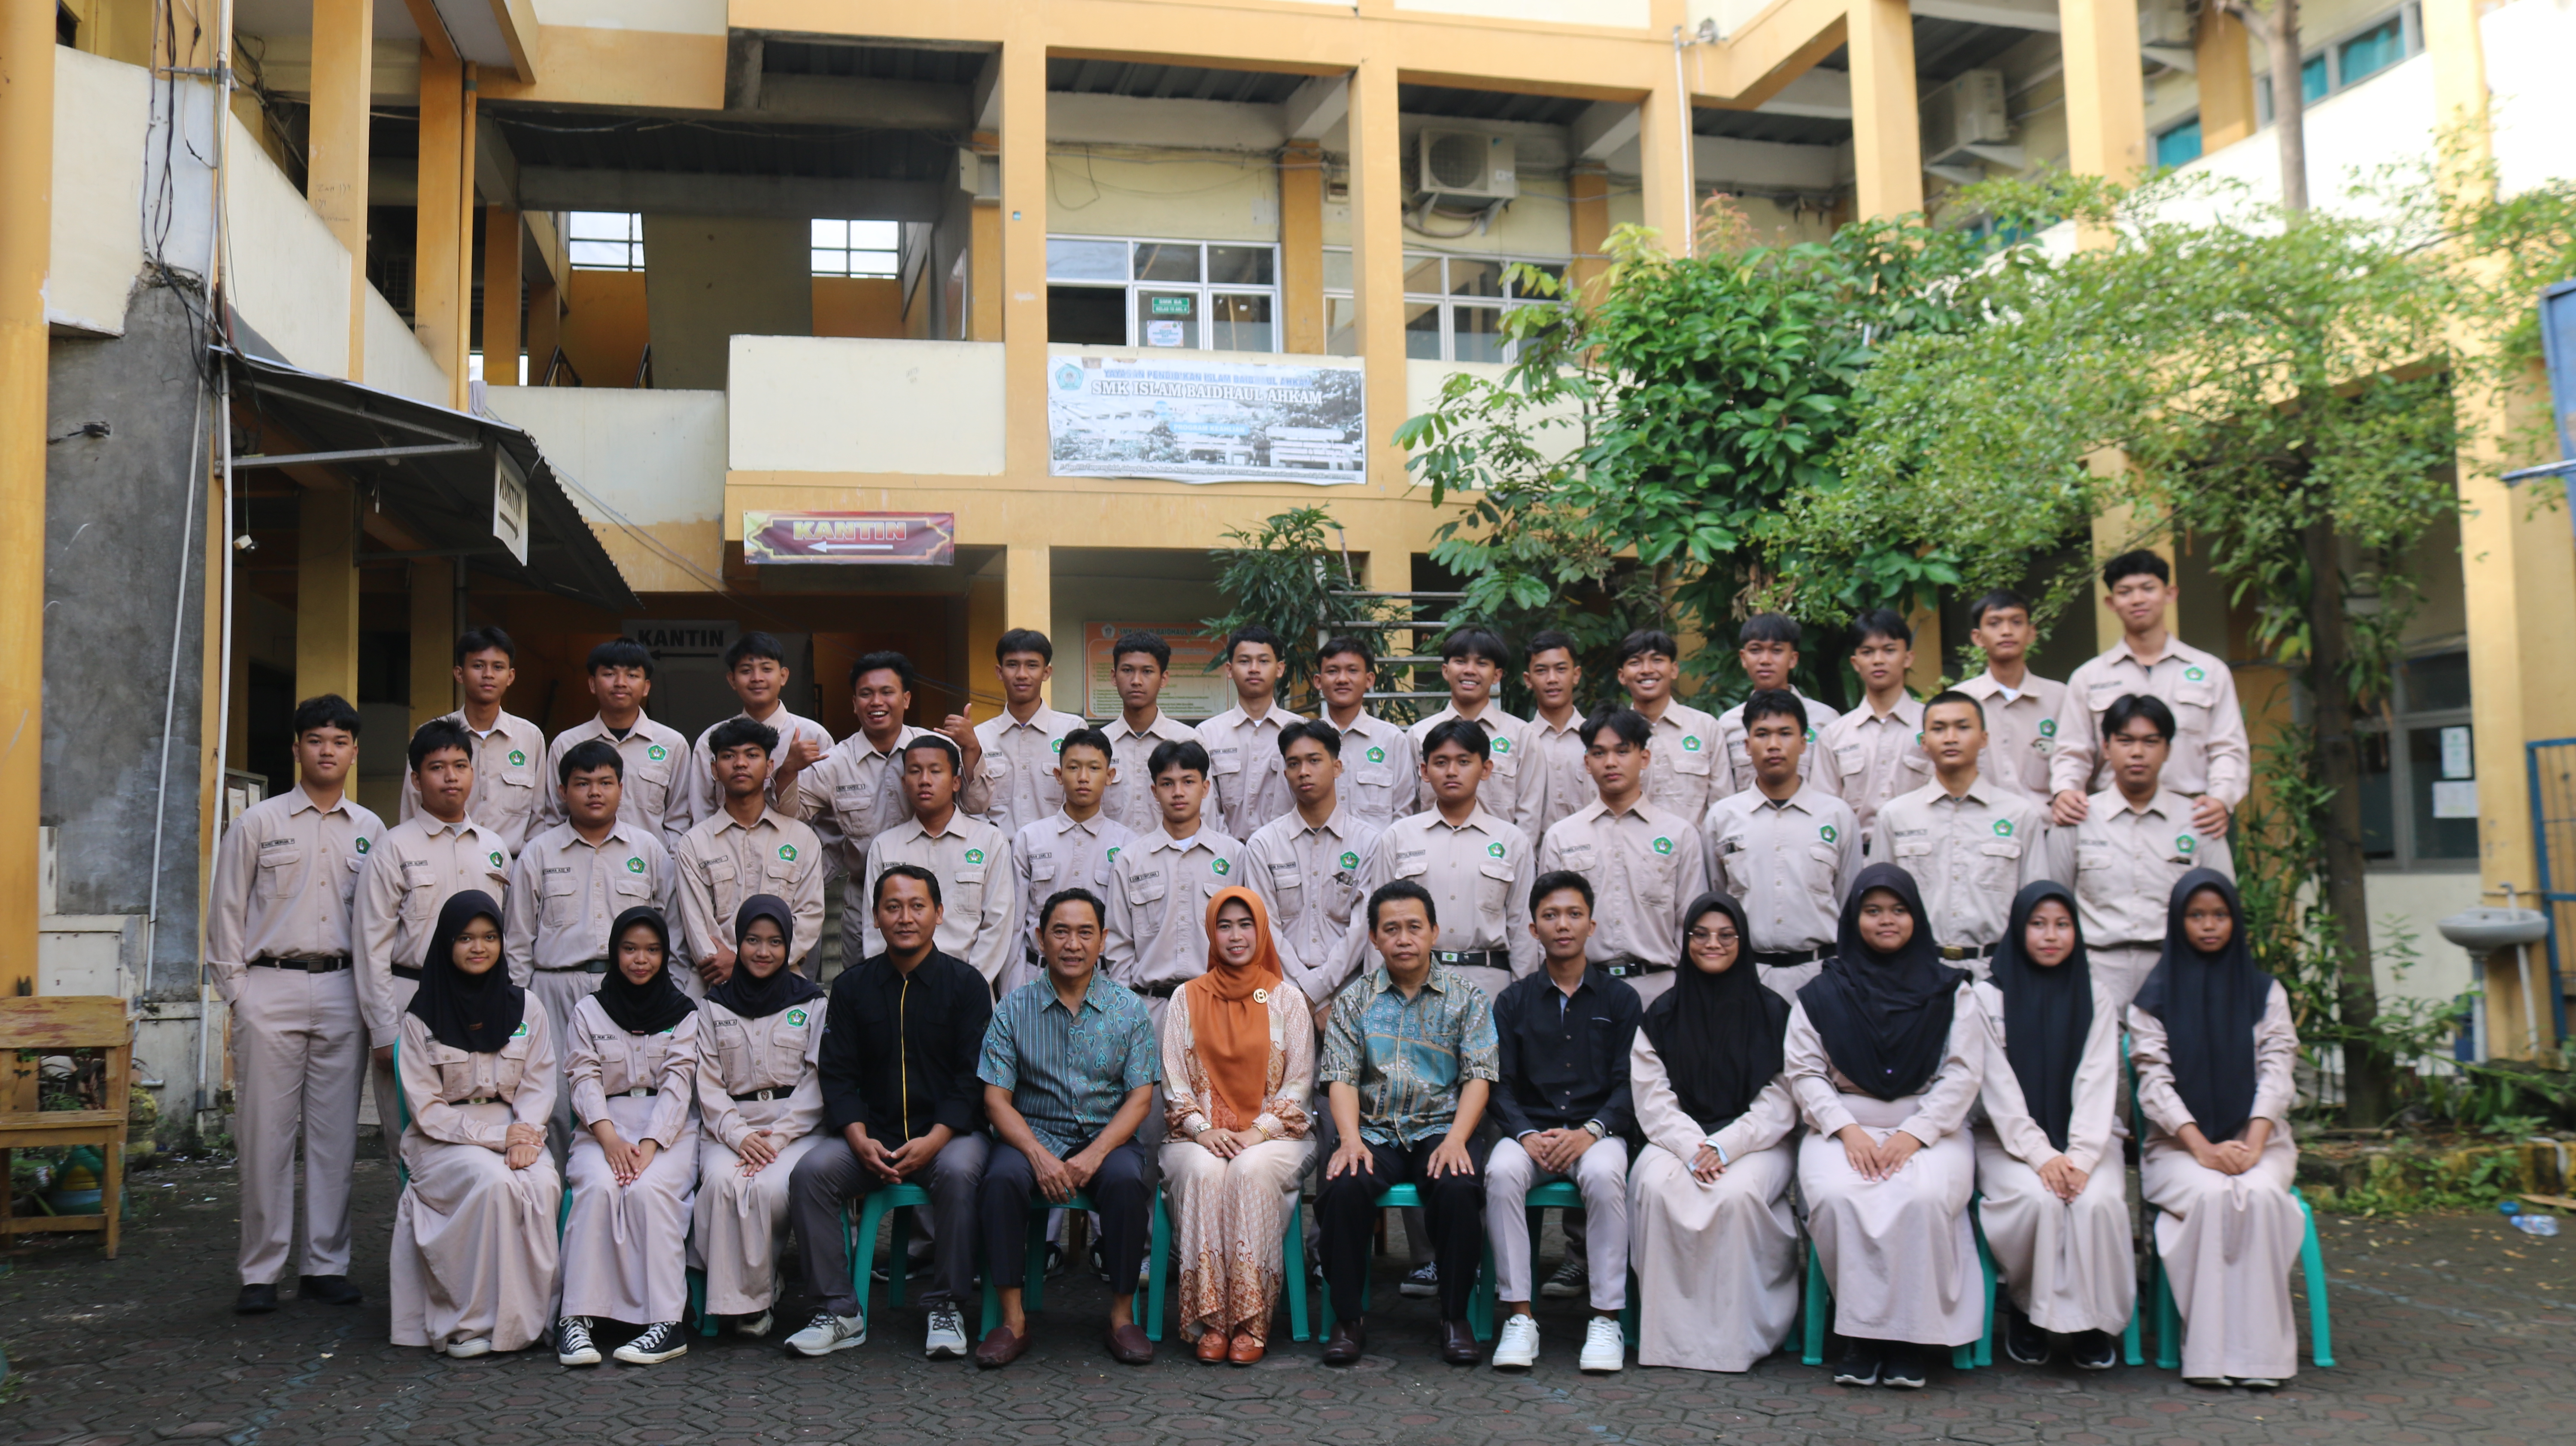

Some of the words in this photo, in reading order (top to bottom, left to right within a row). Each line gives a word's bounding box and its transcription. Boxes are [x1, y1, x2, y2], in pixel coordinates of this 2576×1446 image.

[1104, 369, 1145, 379] YAYASAN
[1204, 373, 1231, 382] ISLAM
[1233, 374, 1278, 386] BAIDUL
[1280, 377, 1312, 387] AHKAM
[1091, 380, 1129, 395] SMK
[1132, 381, 1182, 398] ISLAM
[1185, 383, 1263, 401] BAIDHAUL
[1267, 388, 1323, 404] AHKAM
[499, 470, 522, 521] KANTIN
[793, 521, 907, 541] KANTIN
[638, 629, 723, 647] KANTIN
